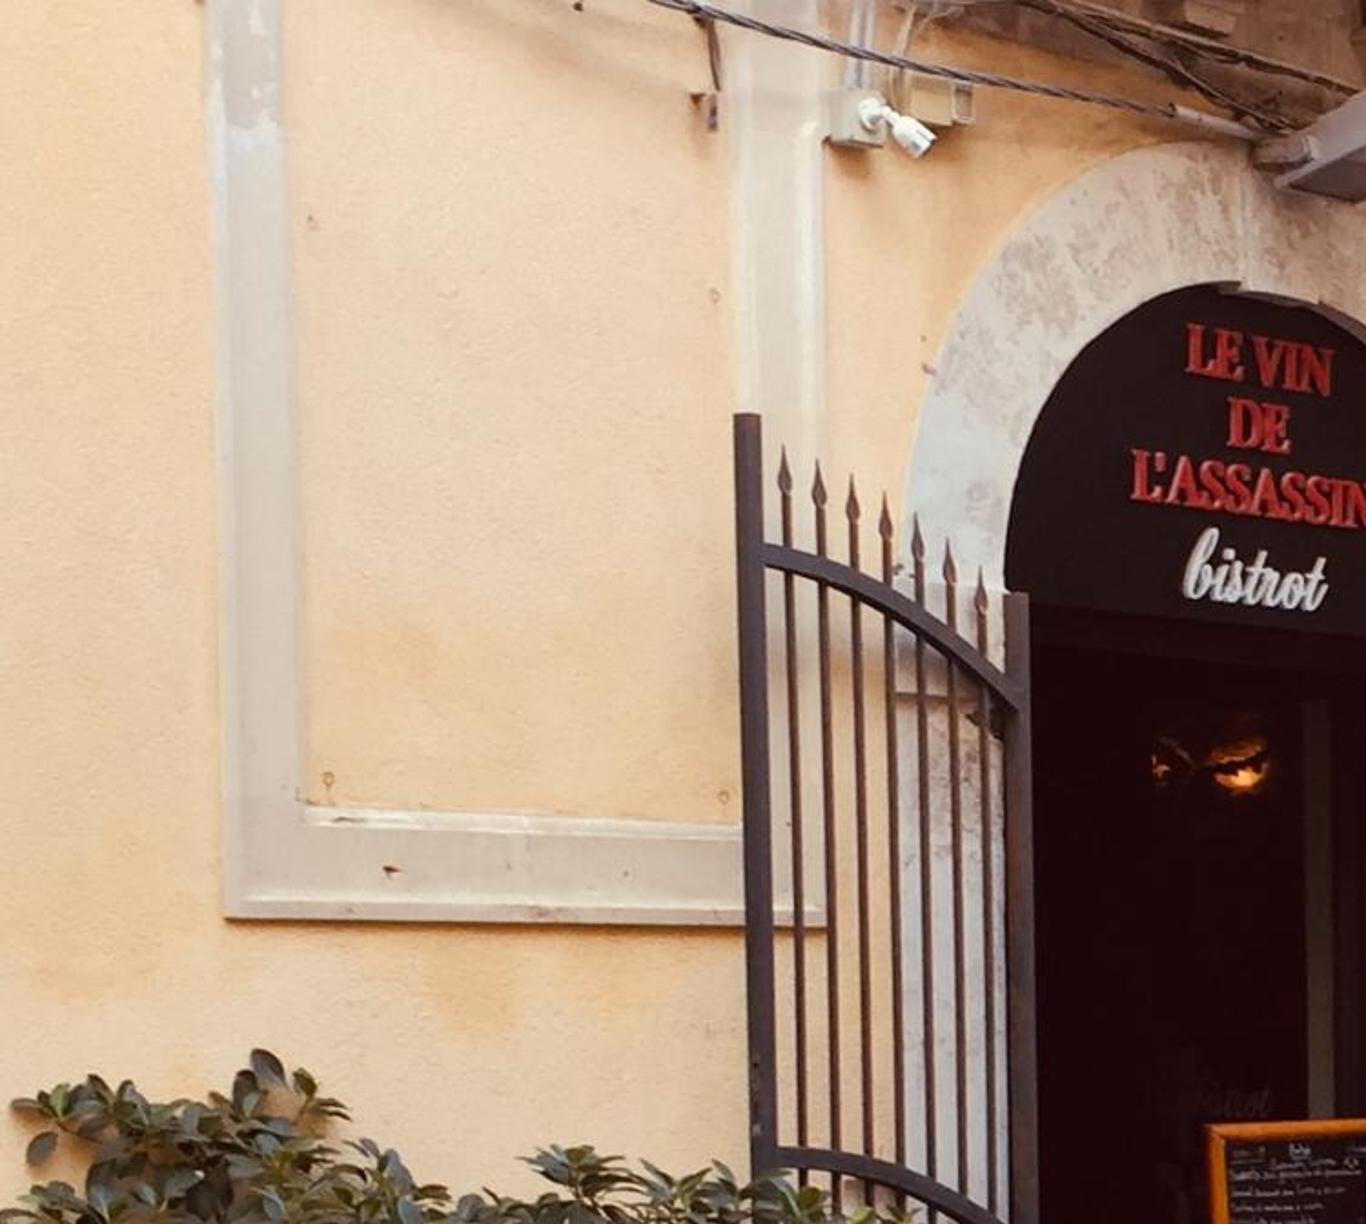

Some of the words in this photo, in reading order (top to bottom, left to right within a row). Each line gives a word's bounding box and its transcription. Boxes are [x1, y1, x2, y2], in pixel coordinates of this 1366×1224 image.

[1185, 322, 1246, 381] LE
[1250, 334, 1335, 397] VIN
[1226, 396, 1292, 454] DE
[1182, 527, 1329, 611] bistrot
